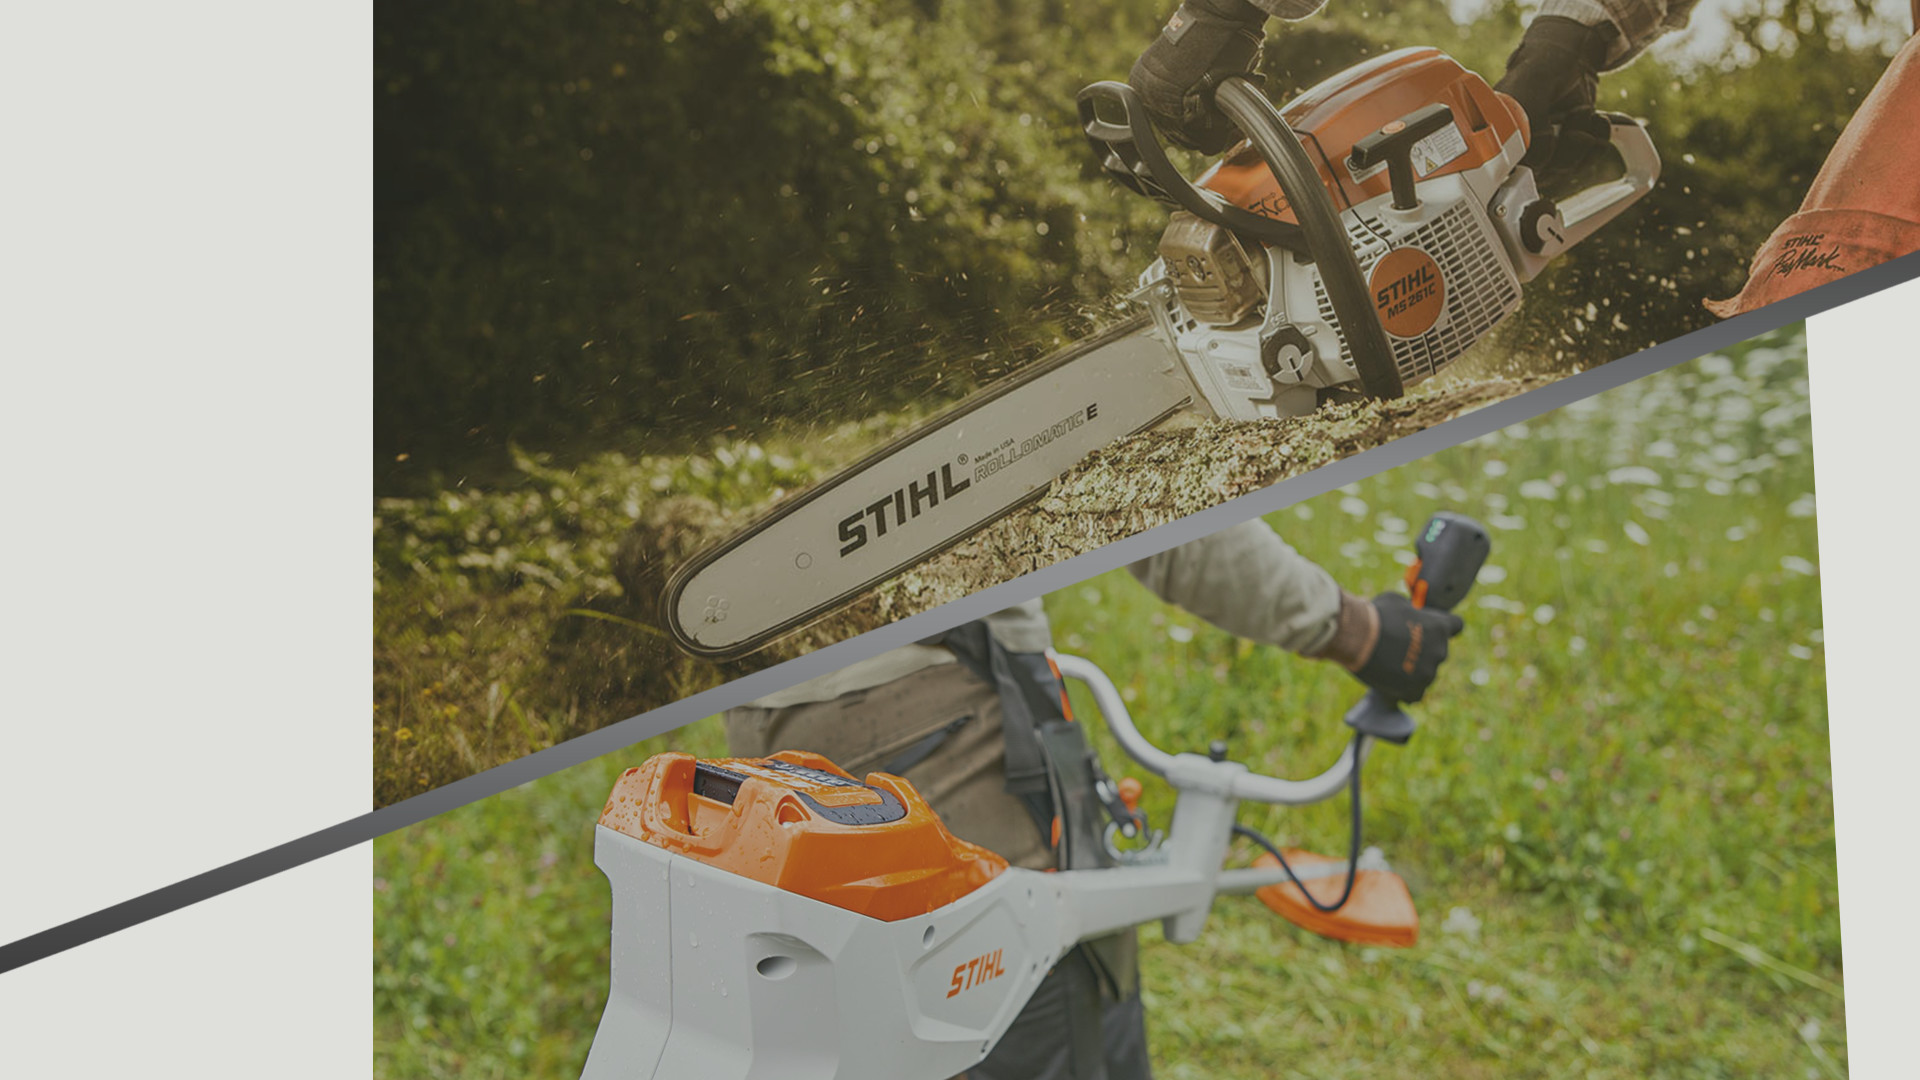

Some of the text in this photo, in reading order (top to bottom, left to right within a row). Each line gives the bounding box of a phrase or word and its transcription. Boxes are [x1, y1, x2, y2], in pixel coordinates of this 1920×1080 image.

[974, 403, 1099, 483] ROLLOMATIC E
[974, 450, 992, 464] Made
[1000, 438, 1015, 450] USA
[946, 948, 1005, 1000] STIHL
